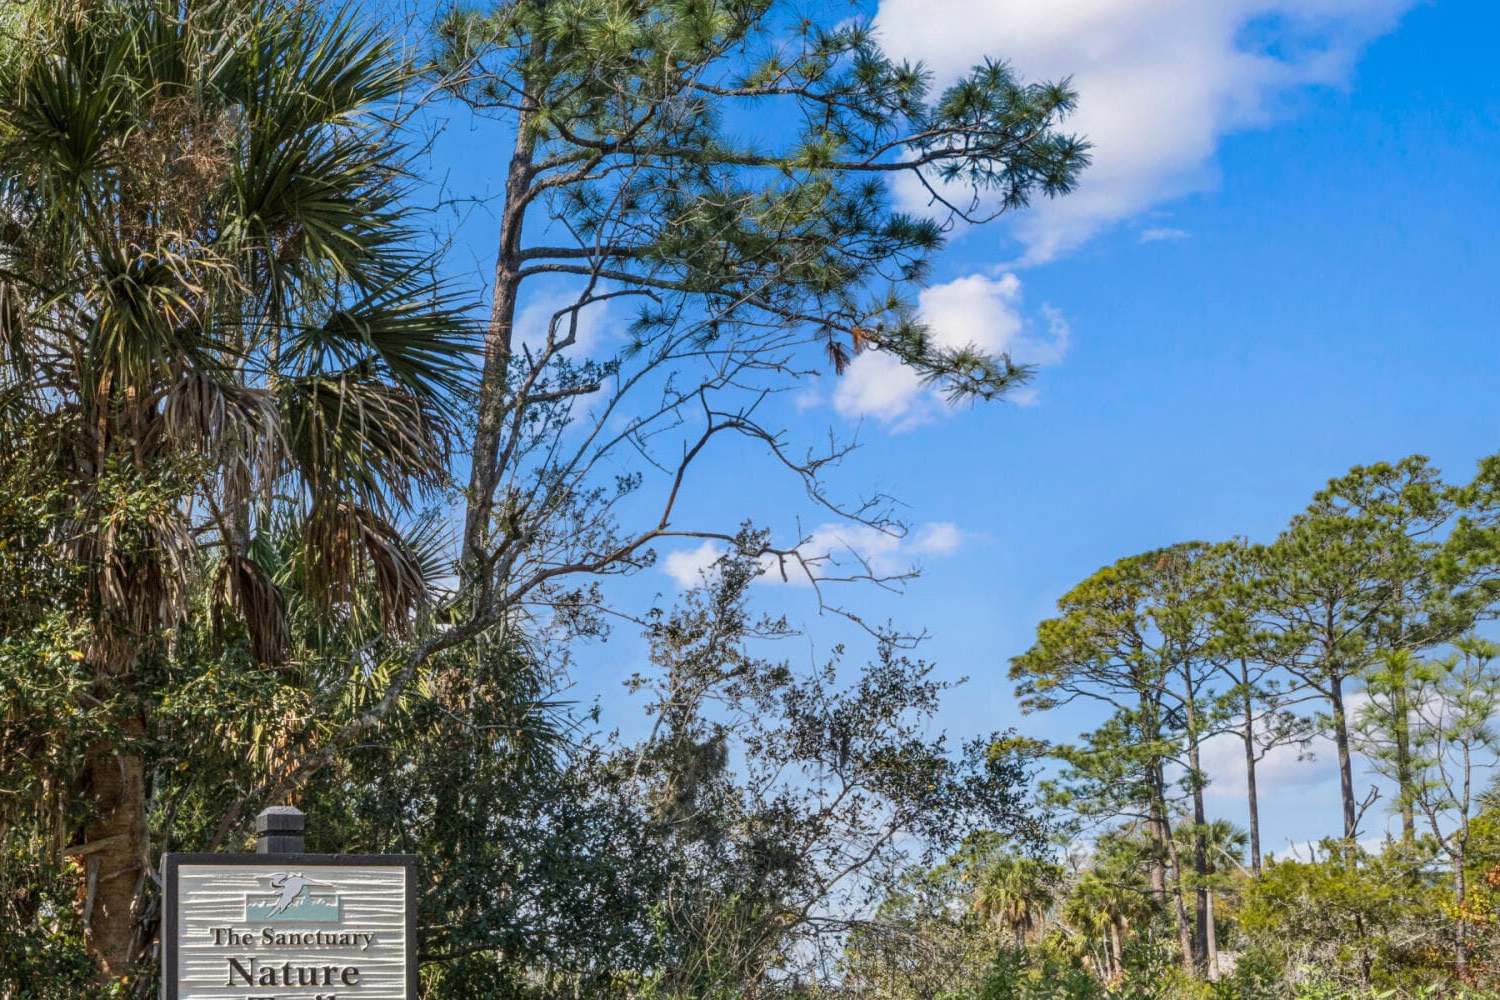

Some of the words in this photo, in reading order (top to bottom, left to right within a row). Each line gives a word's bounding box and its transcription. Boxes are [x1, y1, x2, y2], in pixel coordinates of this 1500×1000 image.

[210, 928, 254, 946] The
[261, 927, 375, 951] Sanctuary
[226, 957, 360, 987] Nature
